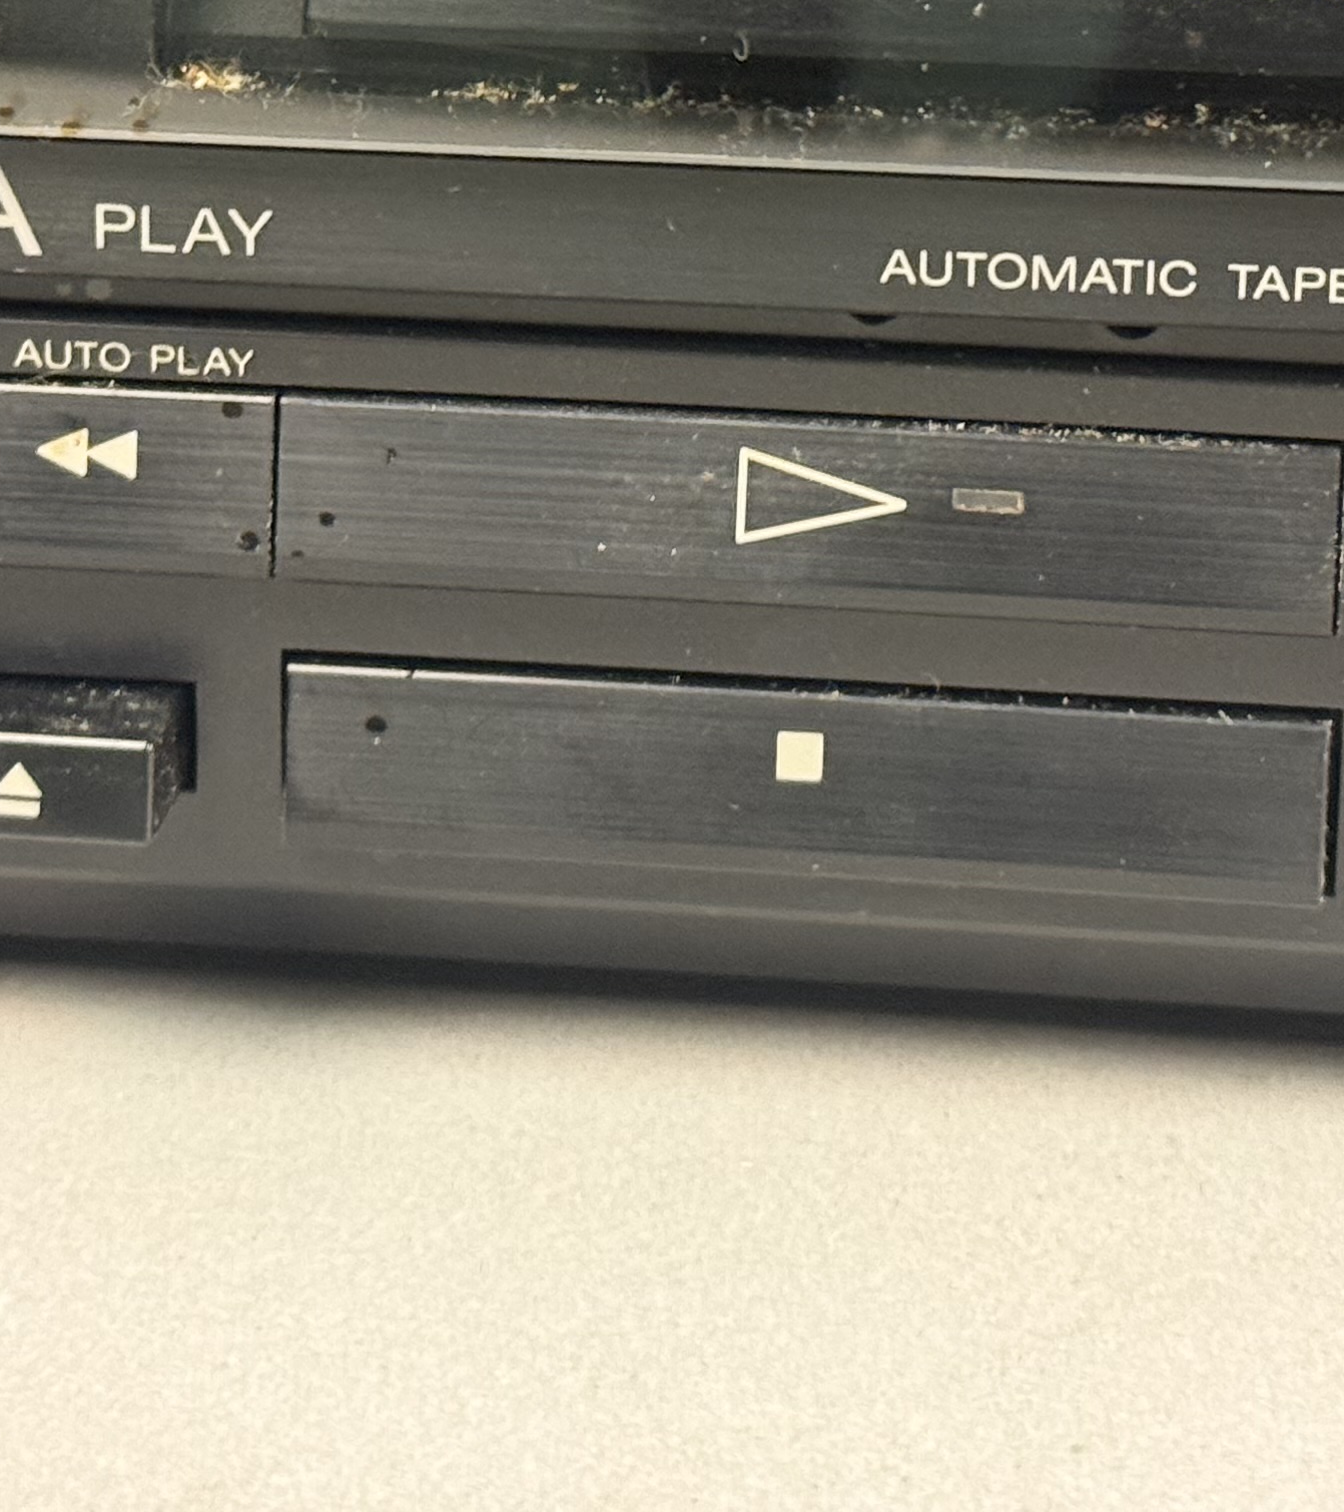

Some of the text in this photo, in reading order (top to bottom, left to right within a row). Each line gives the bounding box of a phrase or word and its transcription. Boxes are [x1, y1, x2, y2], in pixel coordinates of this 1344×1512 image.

[94, 202, 274, 257] PLAY
[878, 248, 1199, 298] AUTOMATIC
[12, 337, 255, 378] AUTO PLAY
